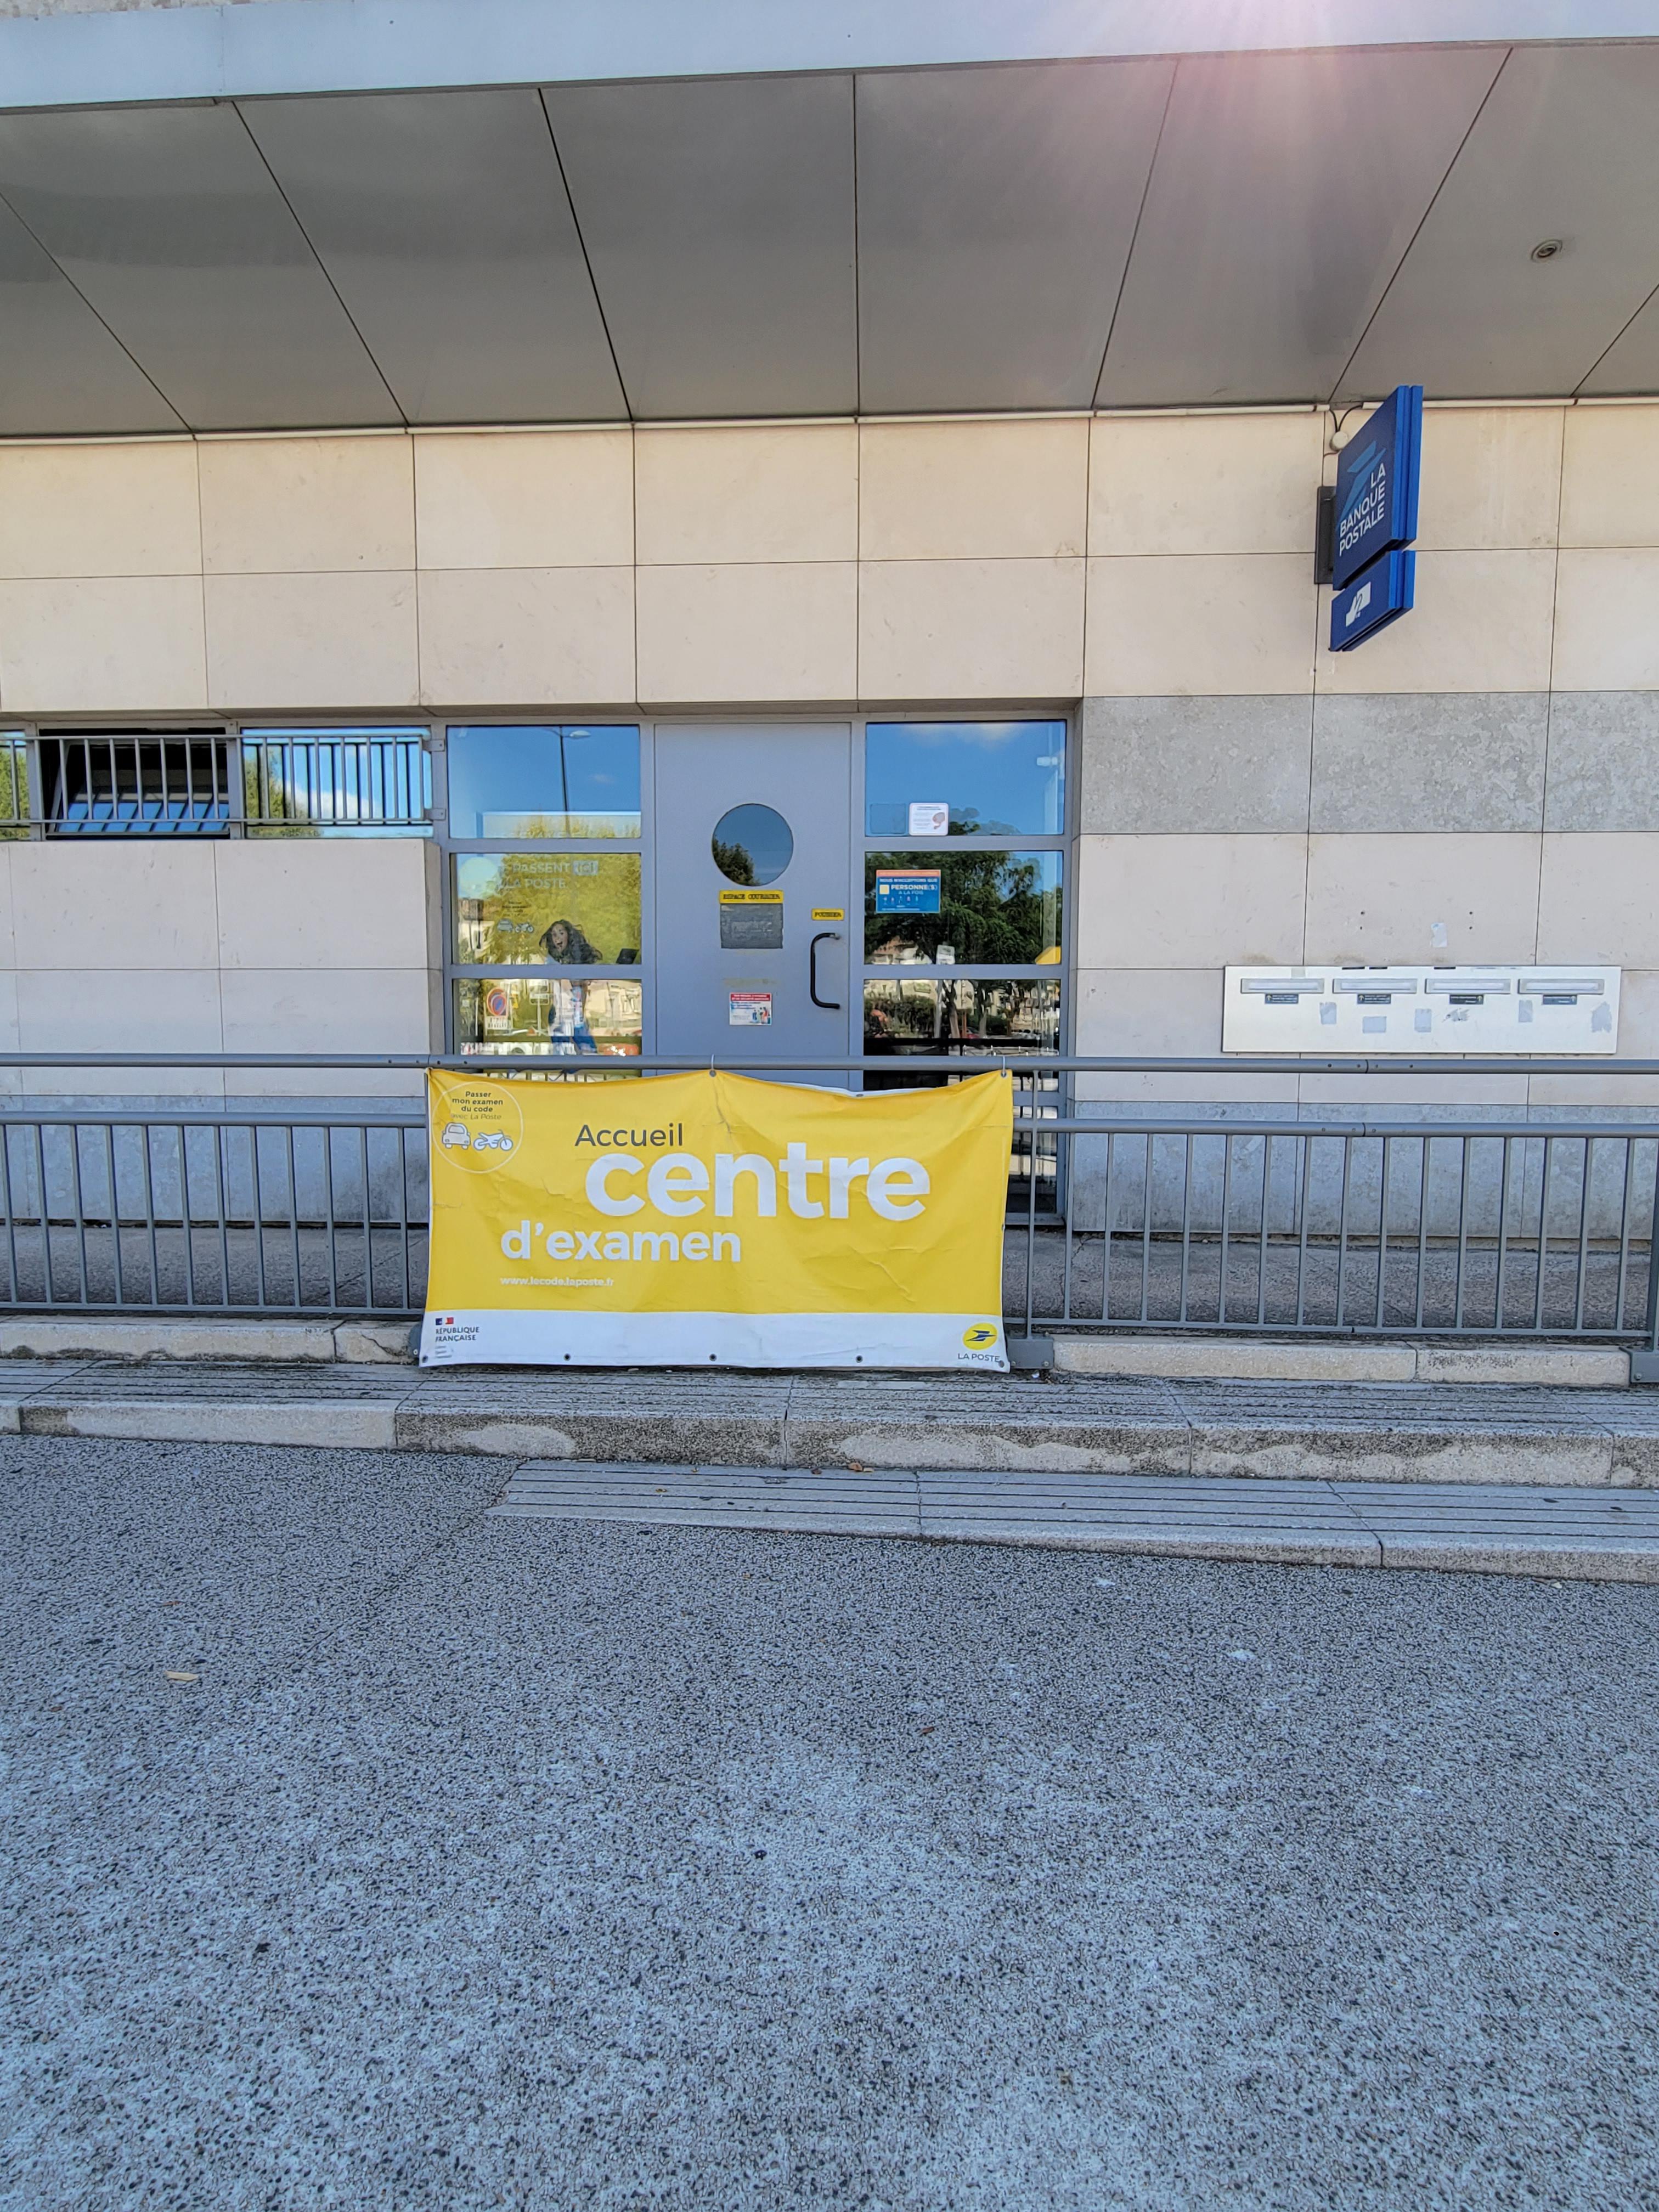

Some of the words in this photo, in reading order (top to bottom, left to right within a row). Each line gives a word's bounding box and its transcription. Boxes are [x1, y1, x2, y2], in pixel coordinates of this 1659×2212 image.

[1371, 462, 1386, 488] LA
[1340, 481, 1385, 538] BANQUE
[1339, 500, 1385, 557] POSTALE
[512, 862, 570, 873] PASSENT
[525, 878, 566, 888] POSTE
[575, 1123, 682, 1147] Accueil
[586, 1142, 930, 1221] centre
[501, 1220, 741, 1262] d'examen
[500, 1276, 614, 1288] www.lecode.laposte.fr
[435, 1326, 480, 1334] RÉPUBLIQUE
[435, 1334, 477, 1342] FRANÇAISE
[971, 1353, 1000, 1362] POSTE
